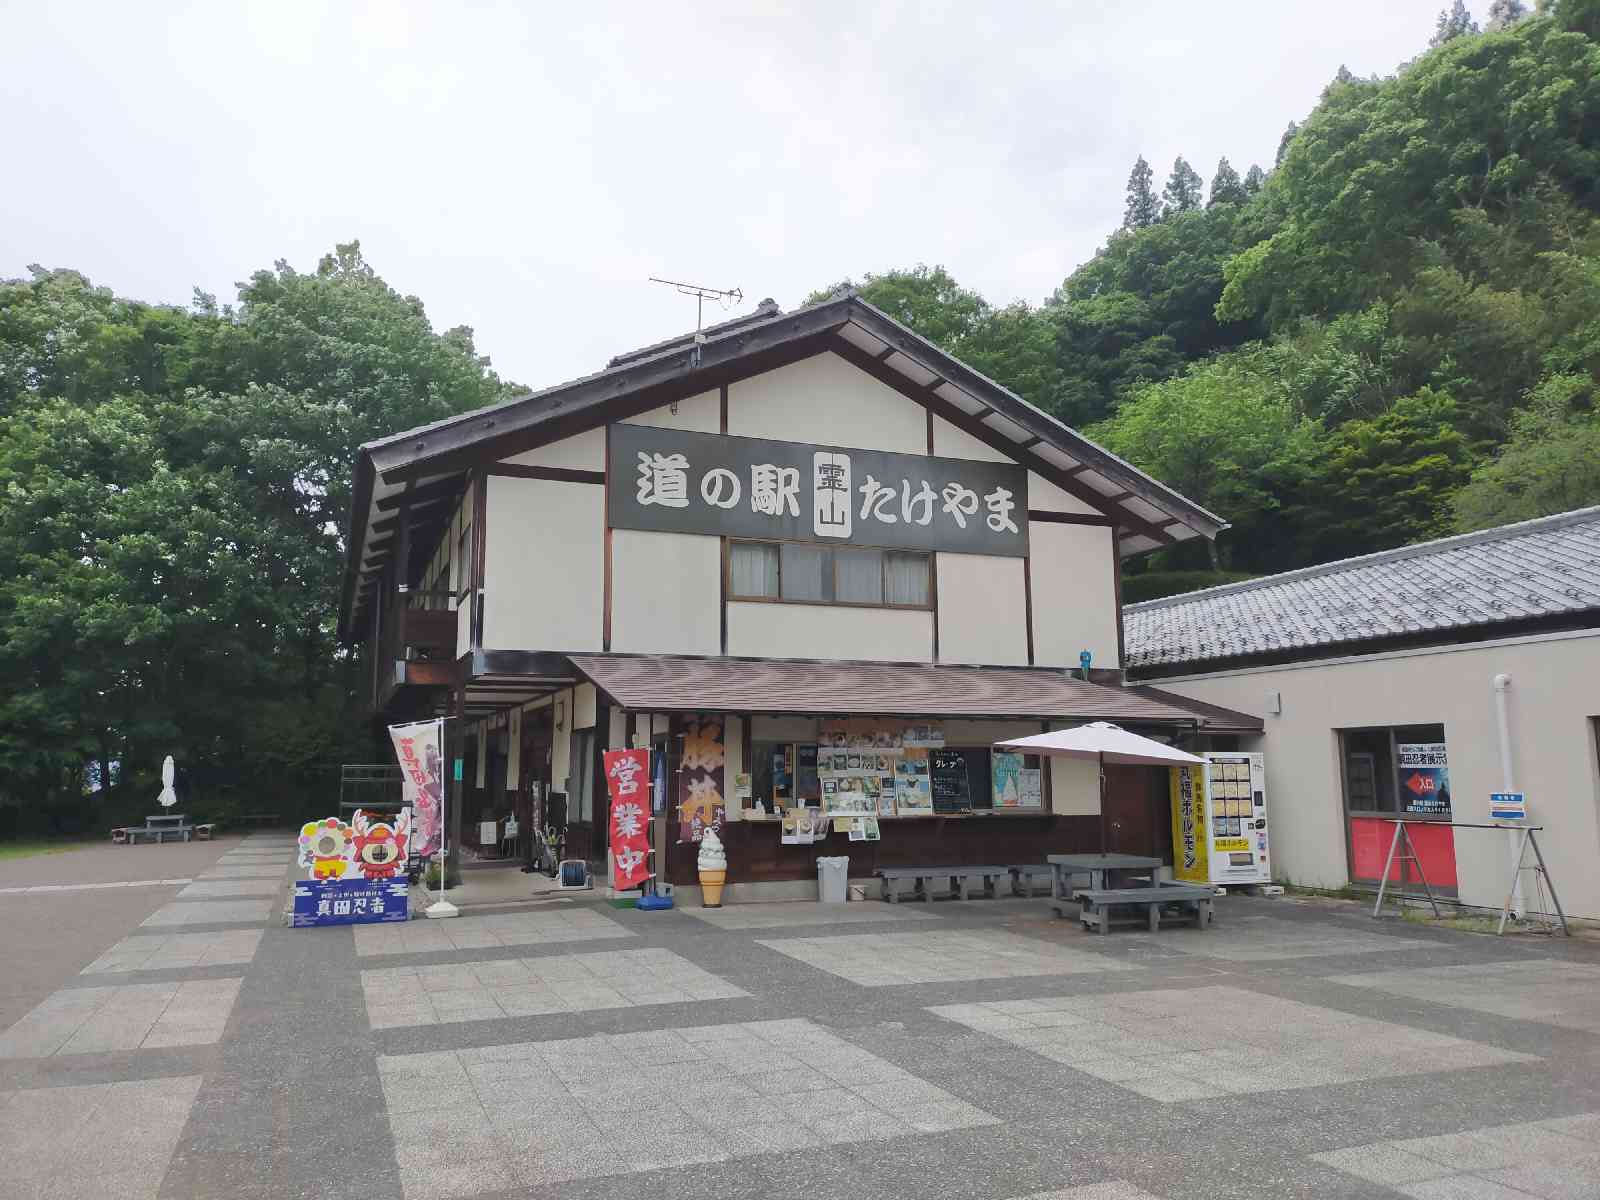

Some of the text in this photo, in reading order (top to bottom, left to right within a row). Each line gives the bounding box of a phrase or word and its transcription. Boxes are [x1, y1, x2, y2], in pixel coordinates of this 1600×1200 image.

[636, 451, 800, 518] 道の駅
[858, 473, 1020, 535] たけやま
[1419, 778, 1434, 790] 入口
[609, 756, 645, 879] 営業中
[315, 897, 386, 917] 真田忍者
